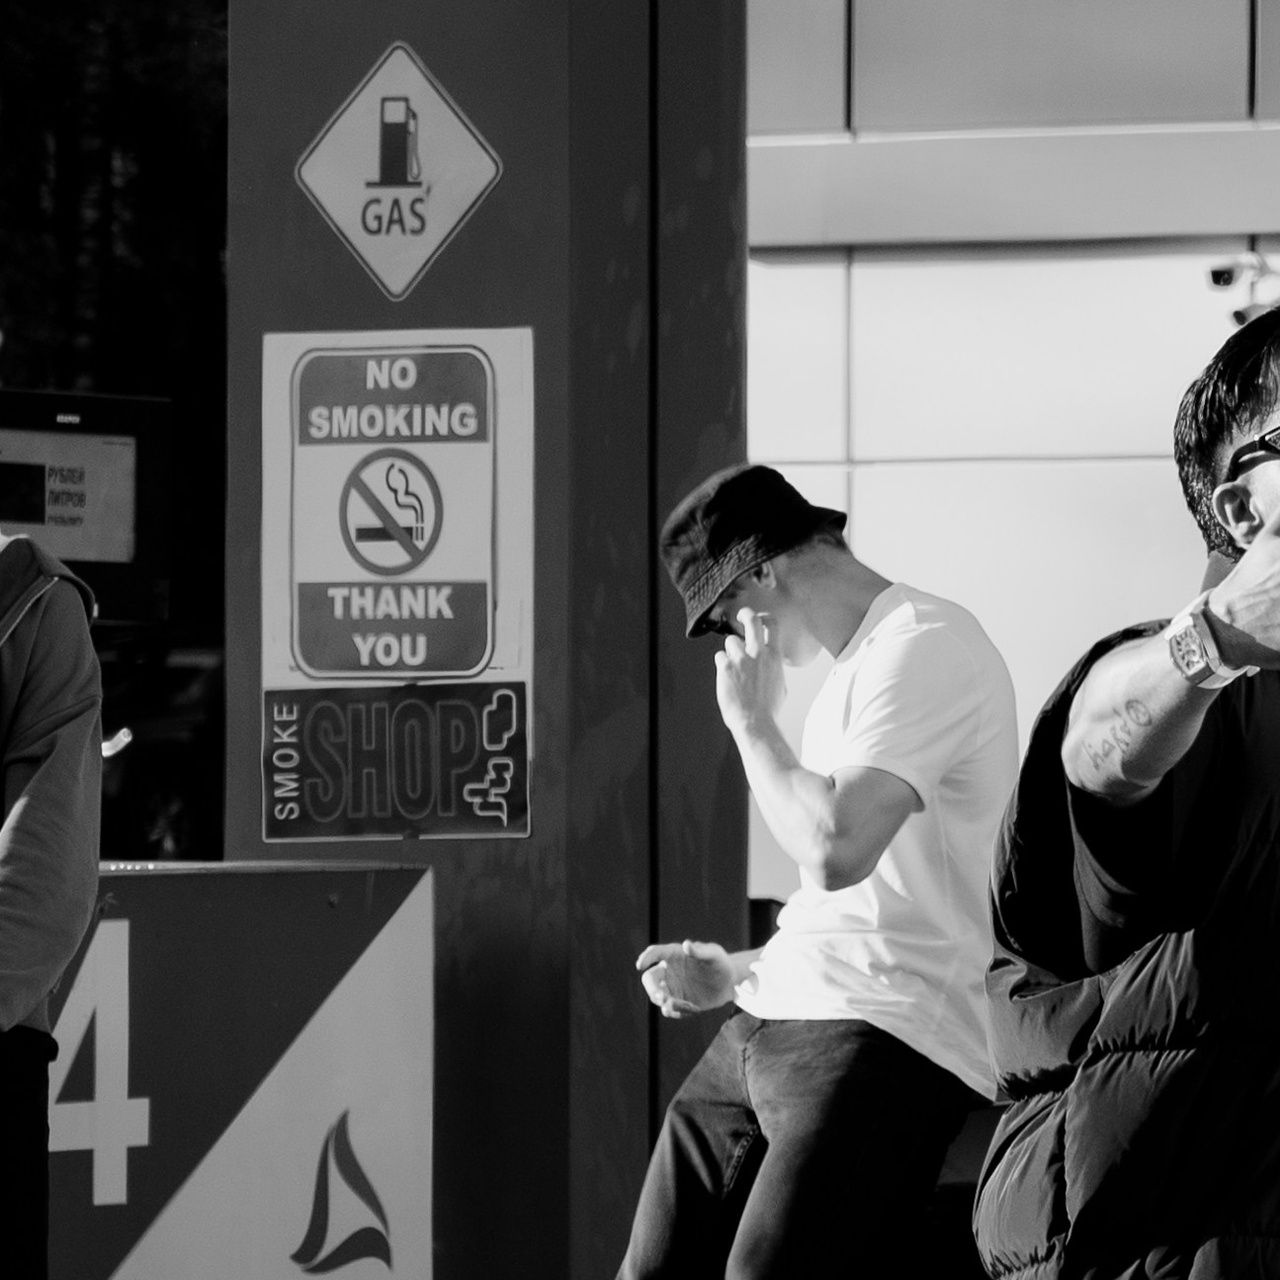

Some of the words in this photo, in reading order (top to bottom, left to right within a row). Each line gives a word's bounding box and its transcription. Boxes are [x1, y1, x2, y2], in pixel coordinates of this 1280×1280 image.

[360, 197, 427, 236] GAS
[366, 357, 417, 390] NO
[308, 403, 478, 439] SMOKING
[327, 586, 454, 620] THANK
[352, 632, 428, 666] YOU
[273, 702, 300, 820] SMOKE
[303, 699, 481, 822] SHOP
